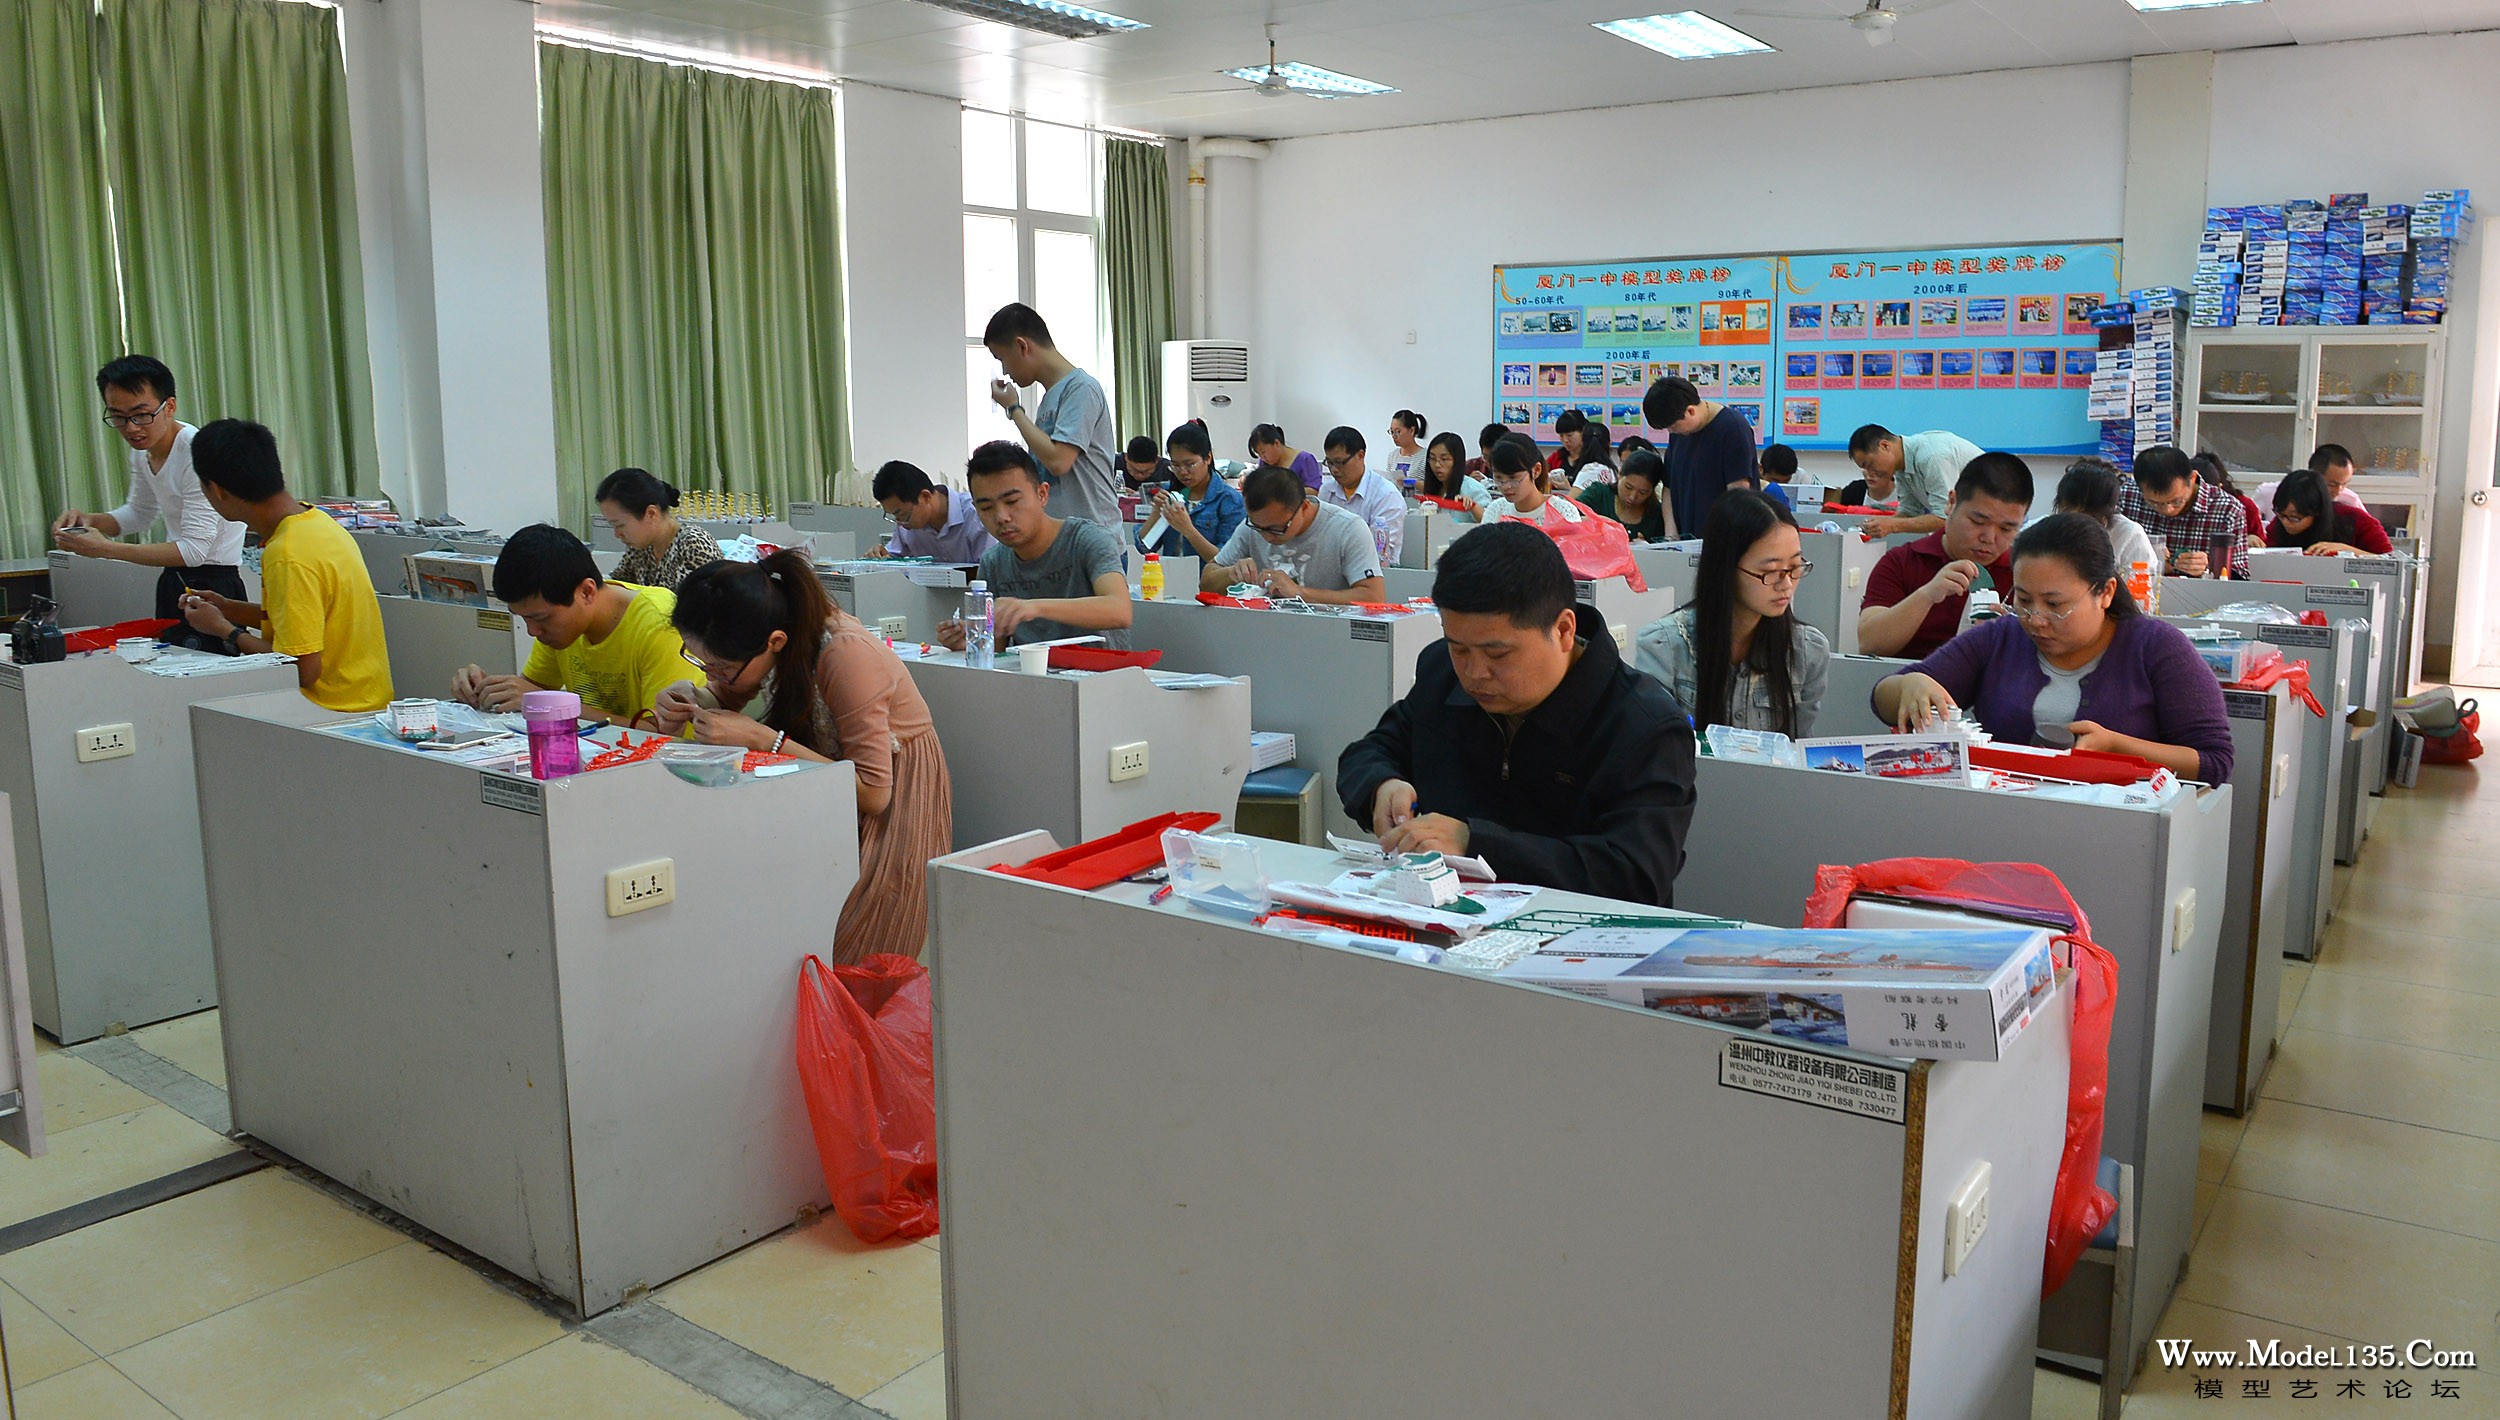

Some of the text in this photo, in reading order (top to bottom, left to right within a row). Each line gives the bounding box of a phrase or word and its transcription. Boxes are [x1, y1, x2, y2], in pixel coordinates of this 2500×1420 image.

[1829, 253, 2066, 279] 厦门一中模型奖牌榜
[1535, 266, 1732, 289] 厦门一中模型奖牌榜
[1624, 292, 1657, 302] 80年代
[1718, 289, 1752, 299] 90年代
[1913, 283, 1968, 294] 2000年后
[1515, 295, 1565, 305] 50-60年代
[1605, 350, 1651, 360] 2000年后
[1729, 1042, 1897, 1092] 温州中教仪器设备有限公司制造
[1729, 1061, 1767, 1076] WENZHOU
[1768, 1069, 1796, 1082] ZHONG
[1797, 1074, 1815, 1087] JIAO
[1817, 1079, 1833, 1090] YIQI
[1833, 1082, 1864, 1097] SHEBEI
[1752, 1078, 1812, 1098] 0577-7473179
[1816, 1092, 1853, 1107] 7471858
[1858, 1101, 1896, 1116] 7330477
